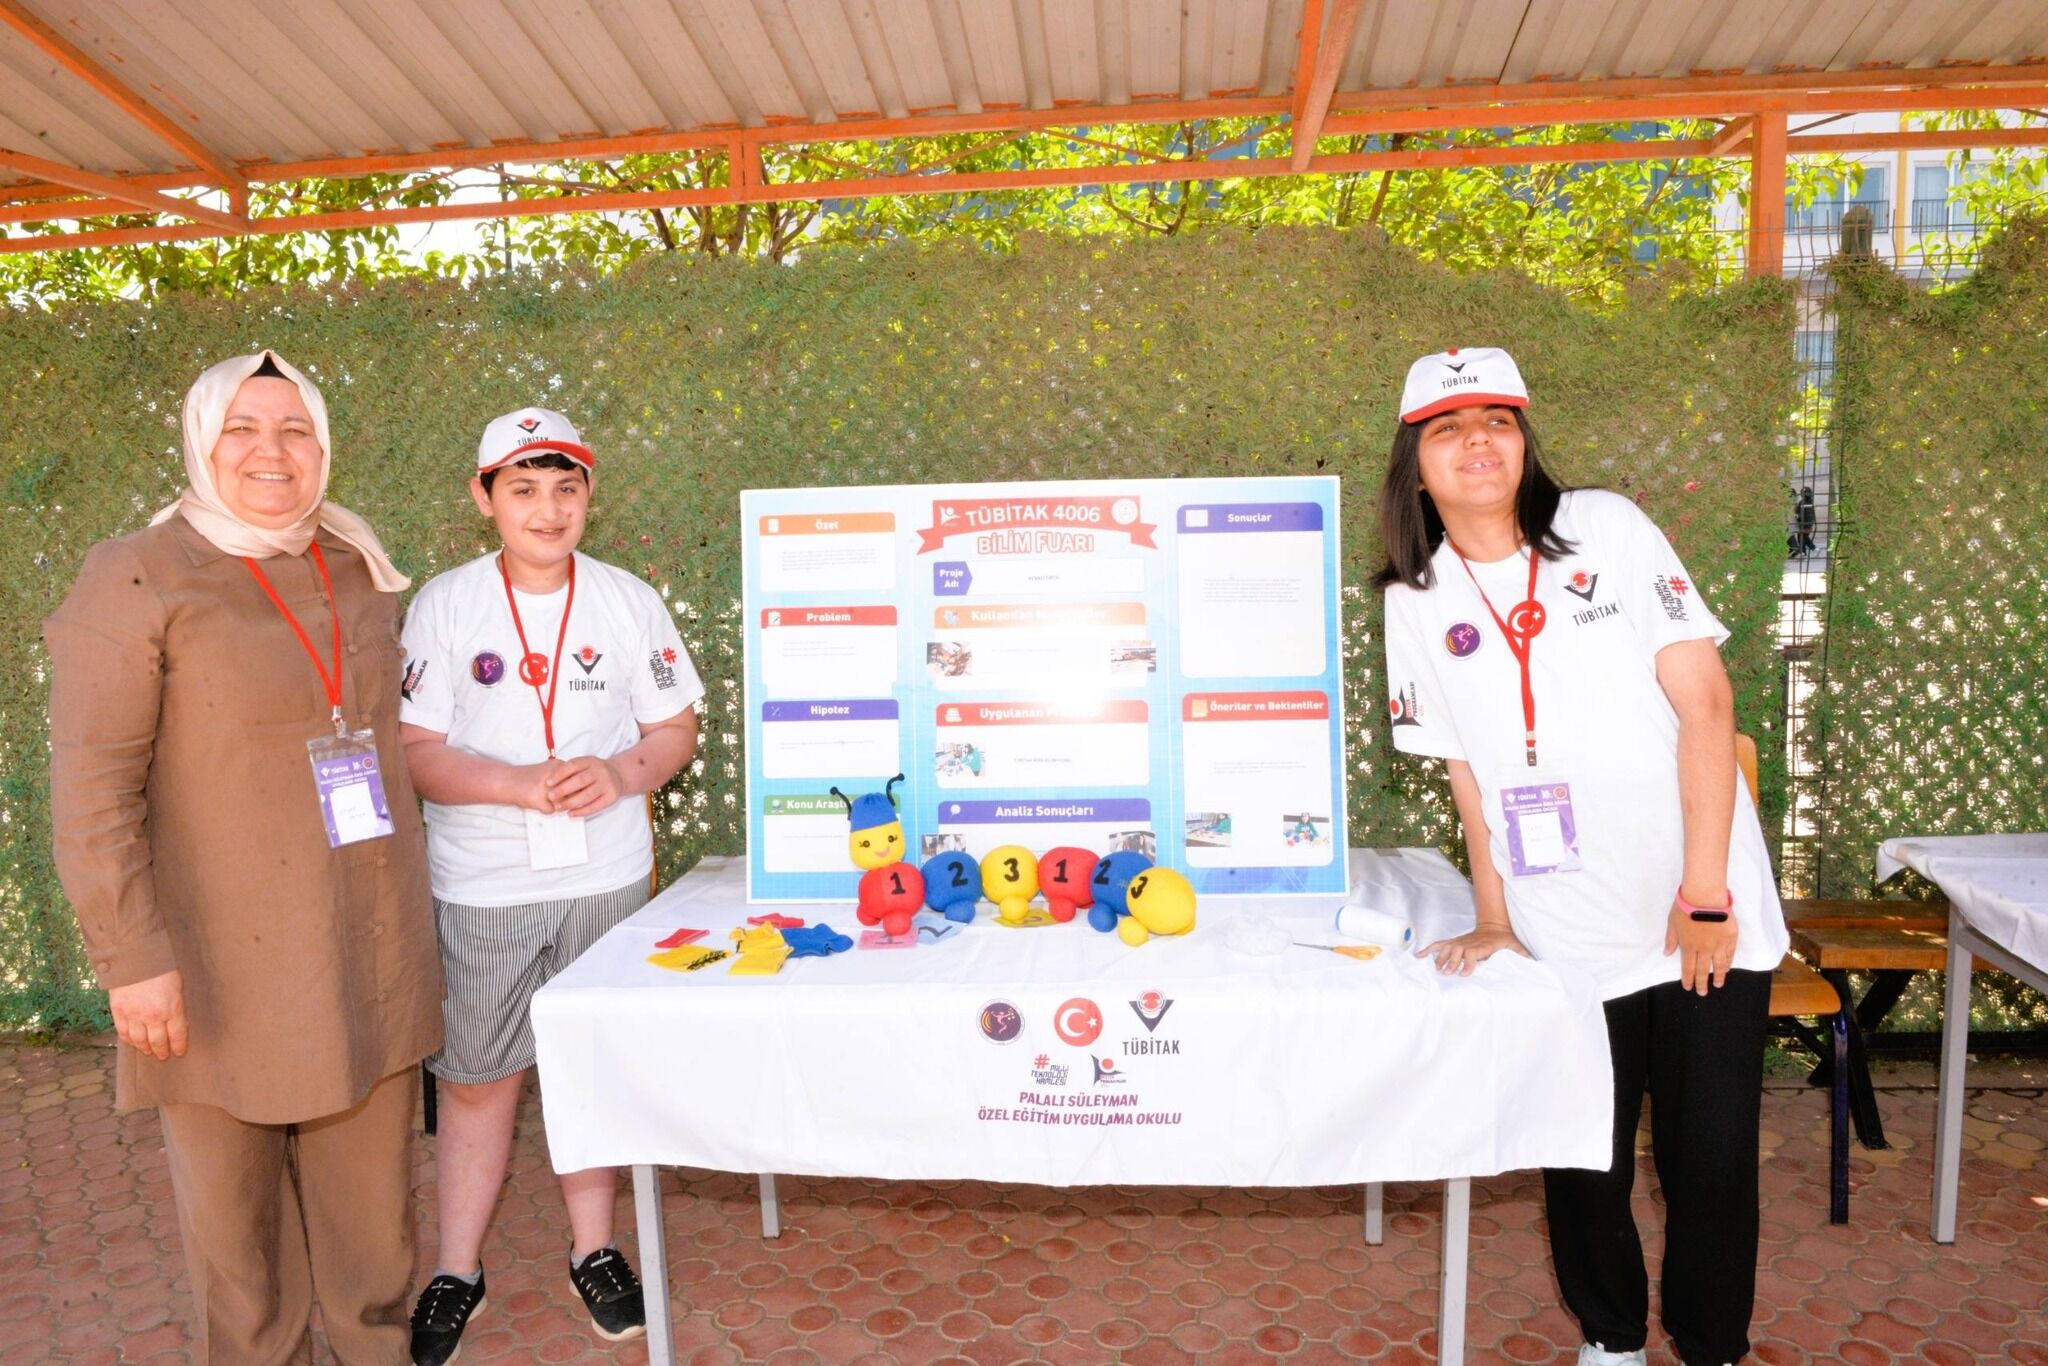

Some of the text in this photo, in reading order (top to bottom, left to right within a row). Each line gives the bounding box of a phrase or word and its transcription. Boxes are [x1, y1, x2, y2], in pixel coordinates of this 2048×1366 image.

[1441, 375, 1479, 389] TÜBİTAK
[965, 503, 1101, 527] TÜBİTAK 4006
[1227, 513, 1272, 525] Sonuçlar
[977, 530, 1095, 555] BİLİM FUARI
[939, 568, 964, 579] Proje
[944, 579, 960, 588] Adı
[806, 611, 851, 623] Problem
[1571, 601, 1620, 627] TÜBİTAK
[568, 677, 606, 691] TÜBİTAK
[810, 705, 850, 716] Hipotez
[1210, 700, 1325, 712] Öneriler ve Beklentiler
[786, 800, 814, 810] Konu
[995, 804, 1094, 818] Analiz Sonuçları
[890, 872, 906, 895] 1
[947, 861, 968, 887] 2
[1003, 858, 1020, 882] 3
[1053, 859, 1068, 883] 1
[1093, 859, 1112, 885] 2
[1122, 1037, 1180, 1056] TÜBİTAK
[1019, 1091, 1138, 1107] PALALI SÜLEYMAN
[978, 1106, 1182, 1127] ÖZEL EĞİTİM UYGULAMA OKULU
